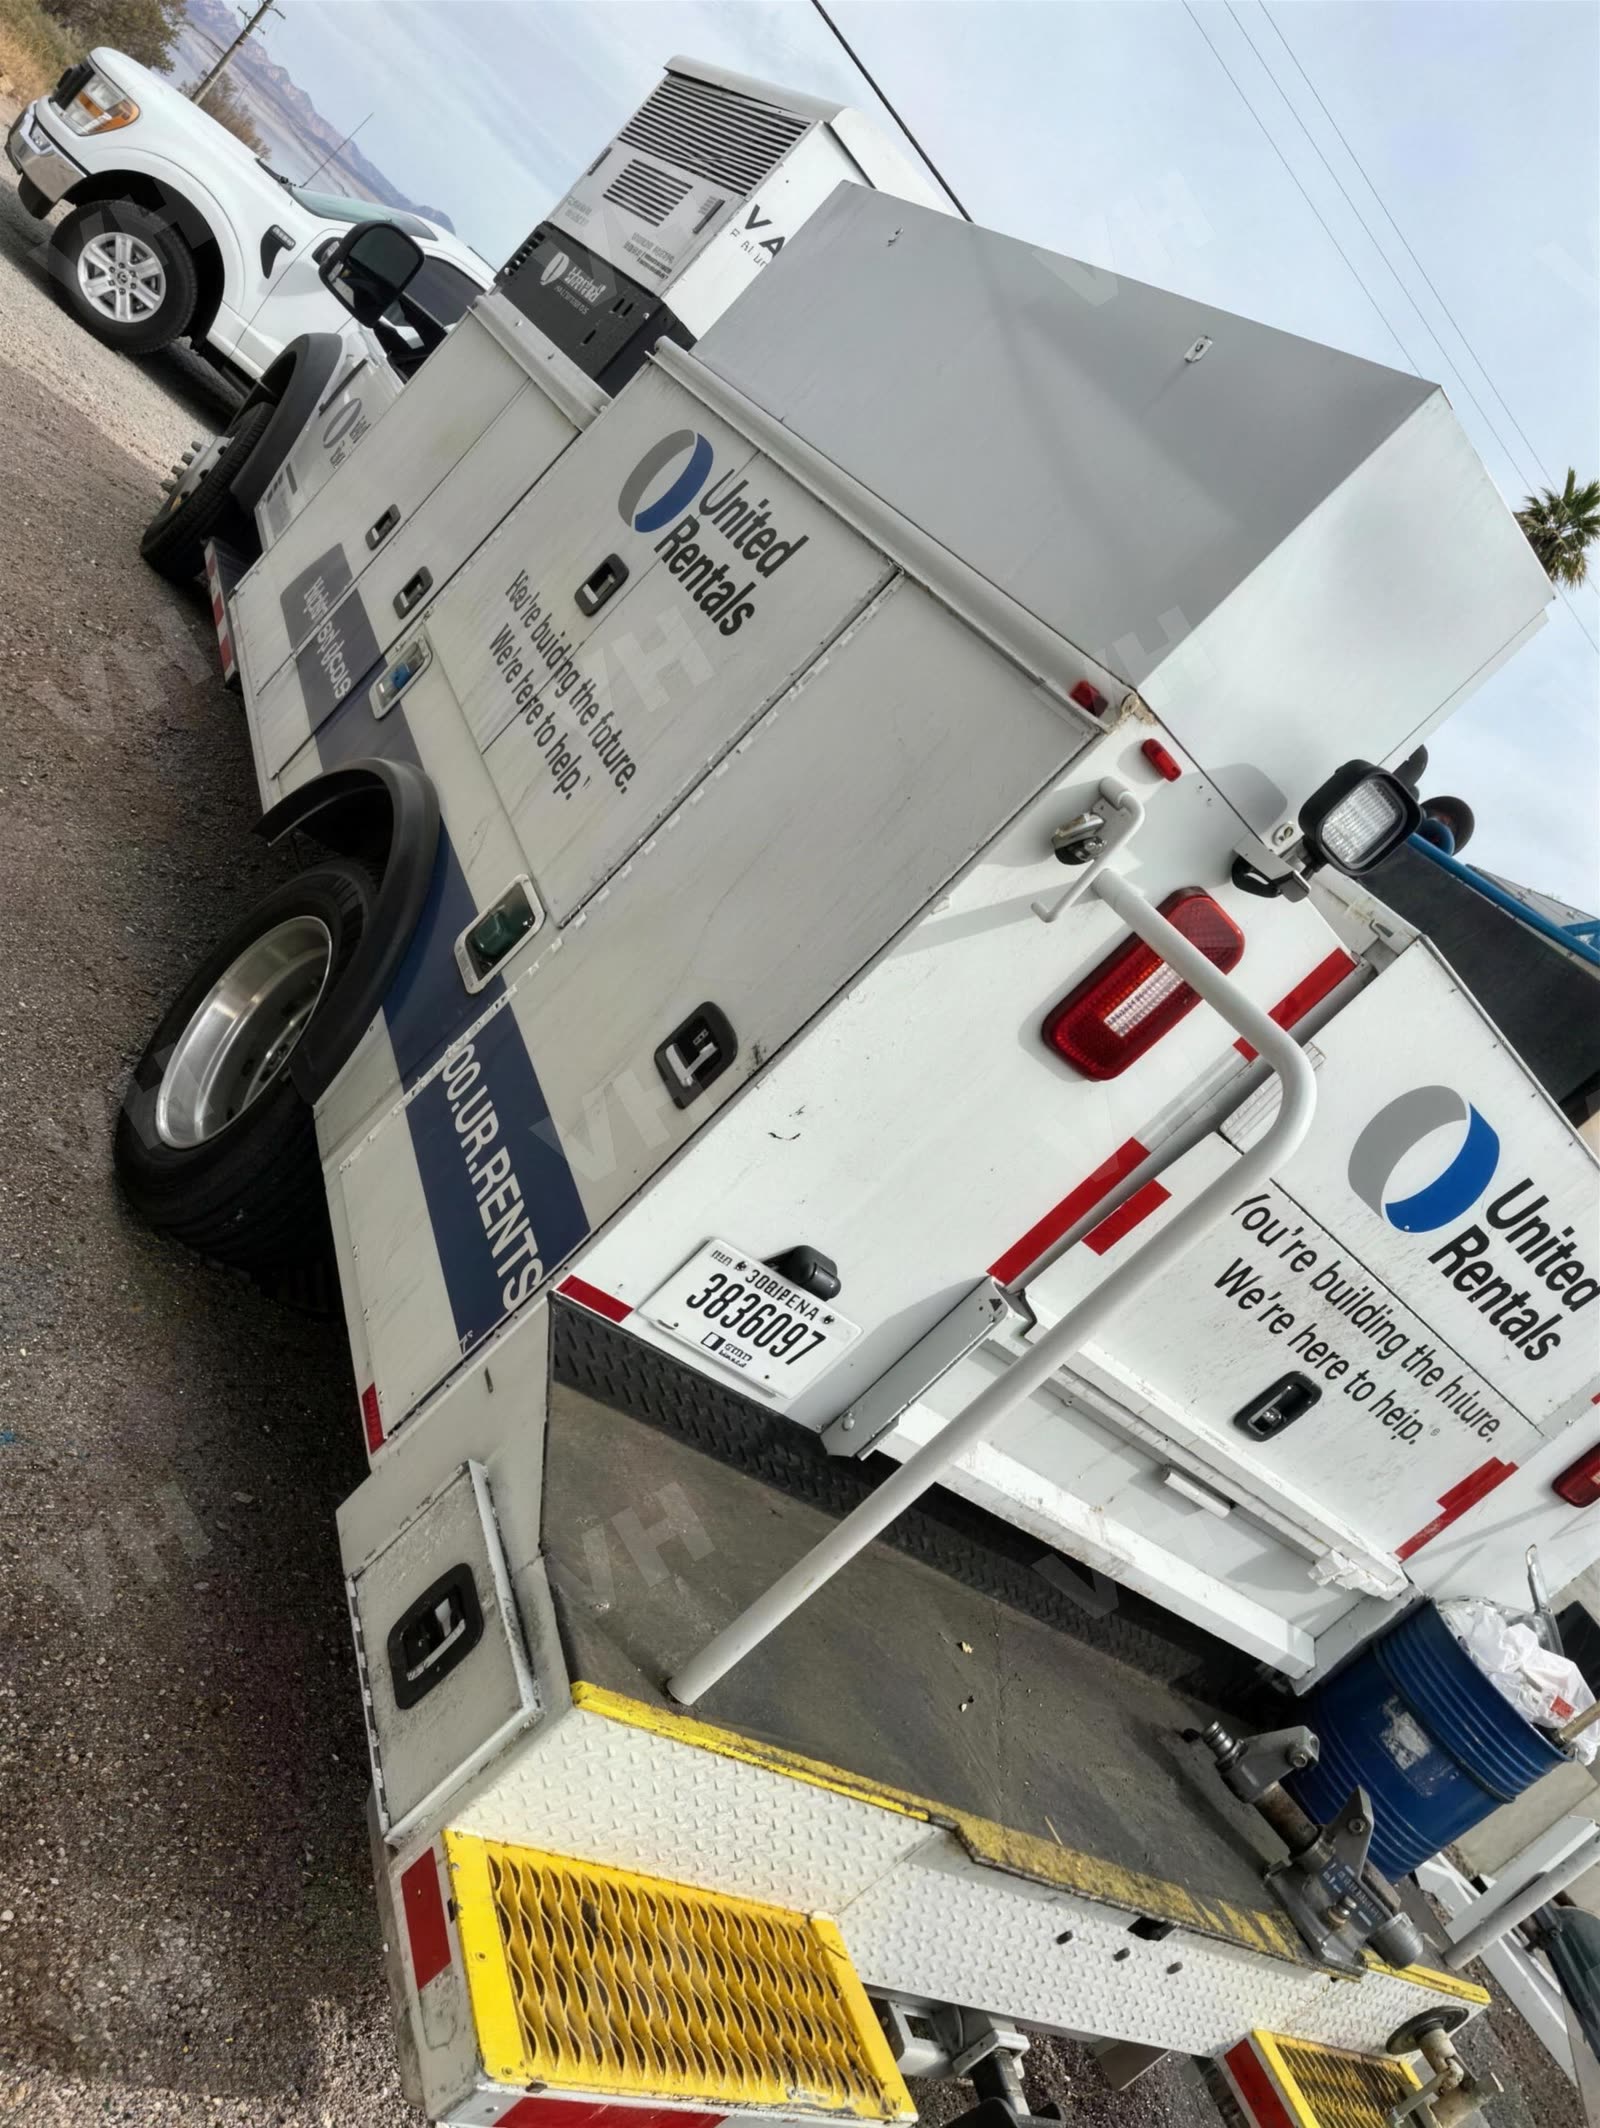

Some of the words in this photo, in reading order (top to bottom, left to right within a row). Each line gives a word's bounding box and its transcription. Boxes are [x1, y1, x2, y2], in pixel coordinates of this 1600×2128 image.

[654, 514, 755, 637] Rentals
[699, 469, 809, 578] United
[489, 623, 524, 684] We're
[533, 711, 556, 747] to
[545, 733, 581, 801] help.
[568, 678, 600, 726] the
[1428, 1224, 1562, 1362] Rentals
[1485, 1177, 1600, 1313] United
[686, 1273, 826, 1365] 3836097
[1213, 1257, 1295, 1335] We're
[1287, 1323, 1348, 1380] here
[1344, 1369, 1376, 1402] to
[1309, 1260, 1410, 1358] building
[1400, 1343, 1445, 1388] the
